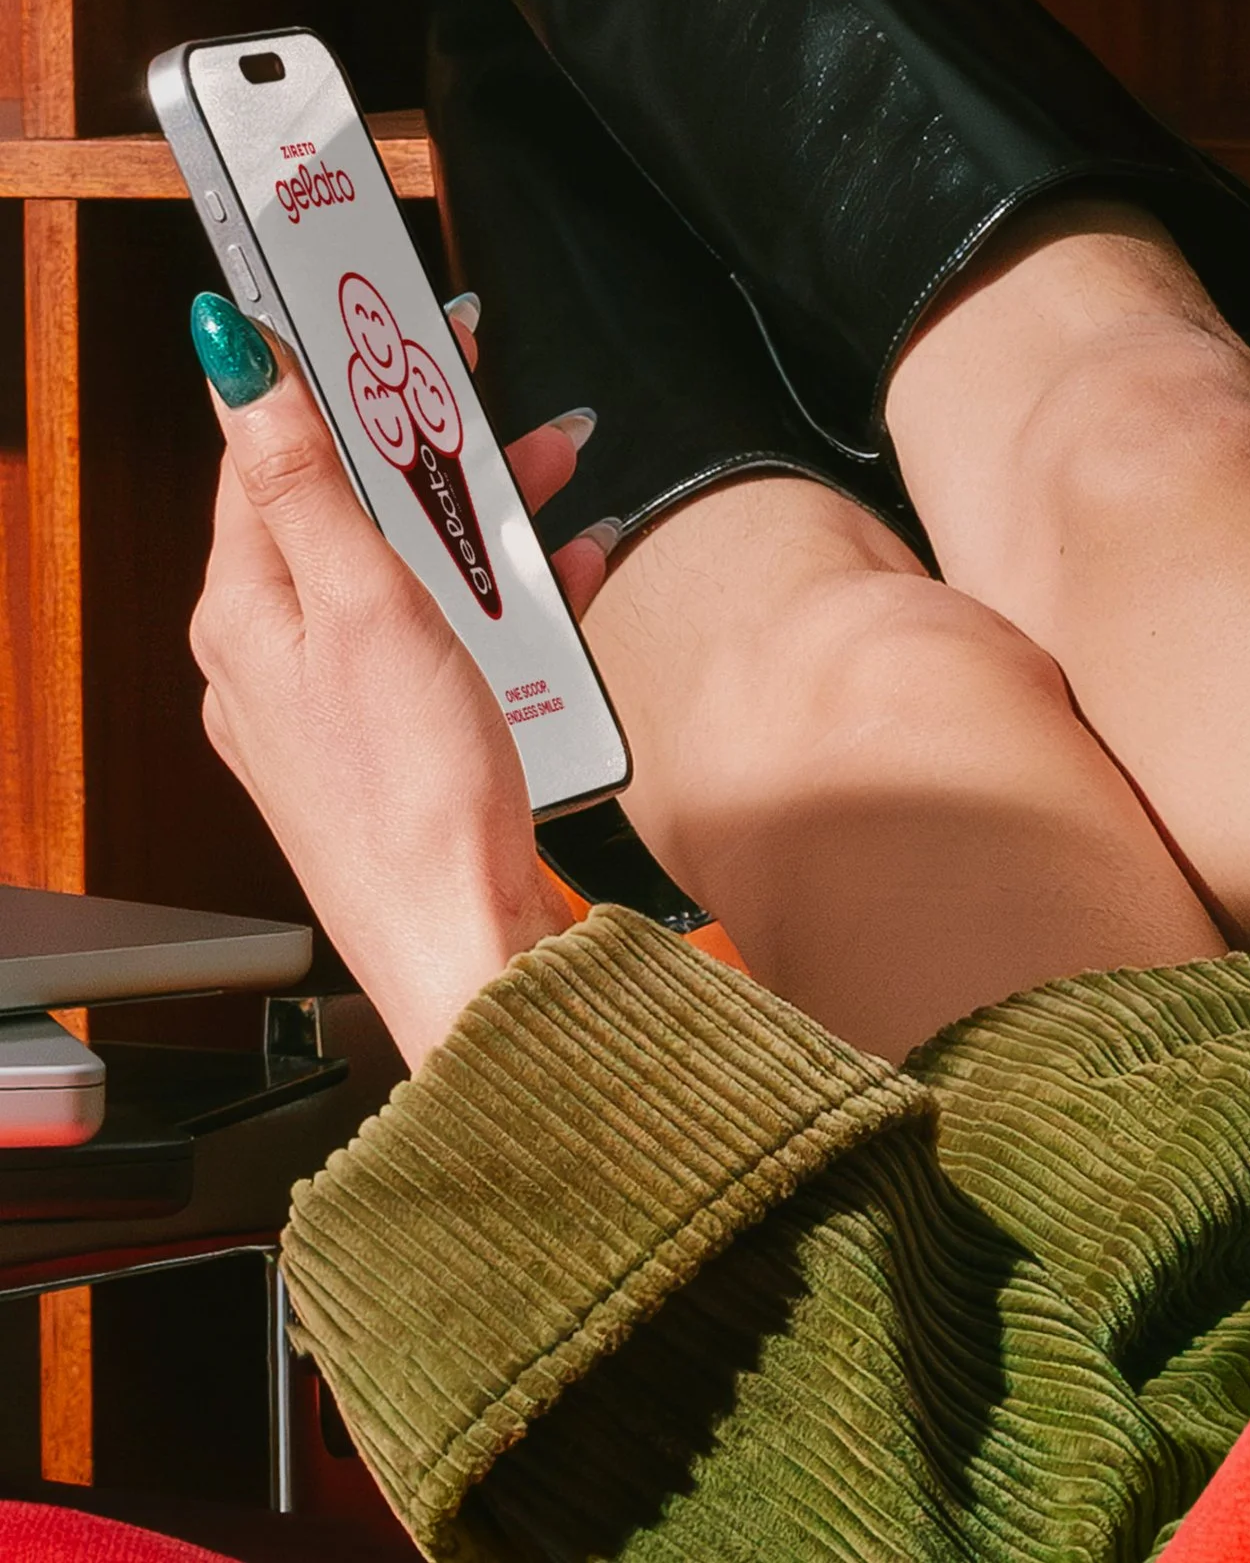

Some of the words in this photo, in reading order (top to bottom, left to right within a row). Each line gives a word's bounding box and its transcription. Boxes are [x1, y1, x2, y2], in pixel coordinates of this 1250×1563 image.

[280, 142, 316, 159] ZIRETO
[275, 160, 355, 224] gelato
[420, 444, 493, 595] gelato
[505, 687, 523, 703] ONE
[505, 704, 539, 726] ENDLESS
